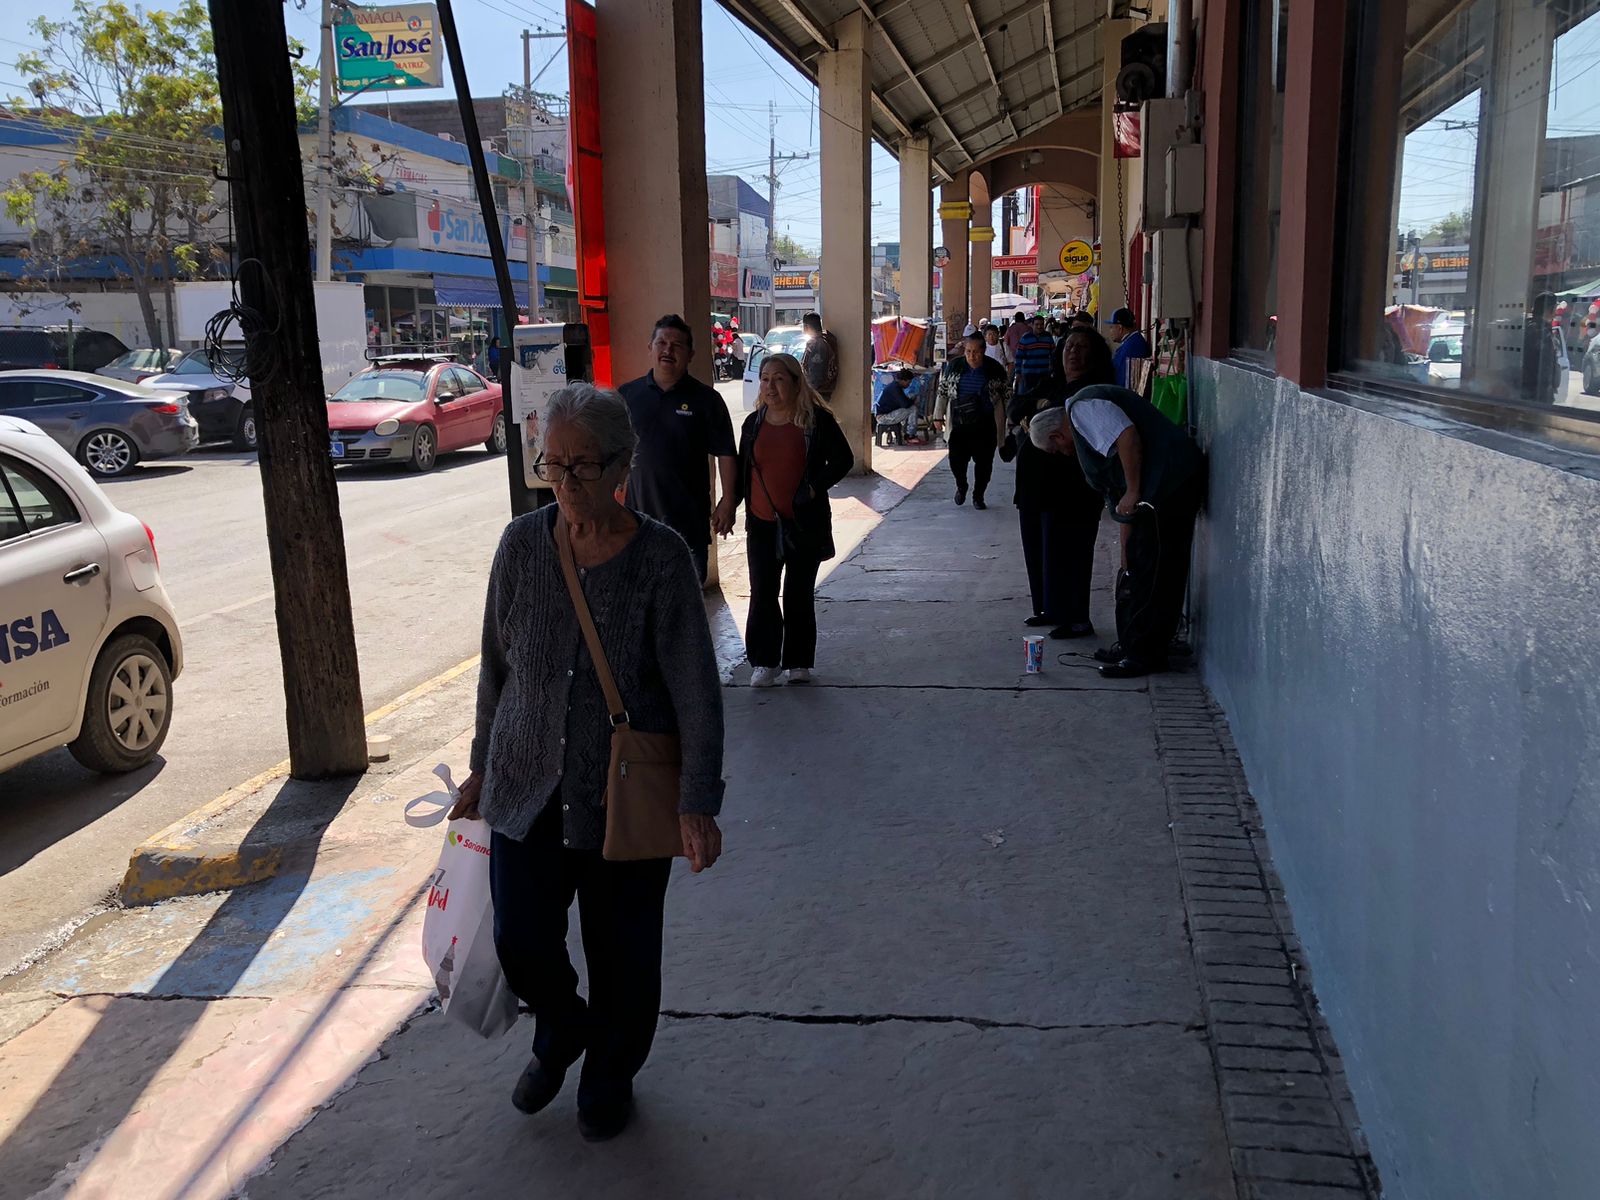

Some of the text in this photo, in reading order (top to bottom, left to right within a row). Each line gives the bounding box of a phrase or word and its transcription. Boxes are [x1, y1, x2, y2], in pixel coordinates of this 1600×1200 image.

[341, 31, 431, 60] San José
[396, 61, 424, 69] MATRIZ
[446, 208, 469, 242] San
[1064, 254, 1089, 264] sigue
